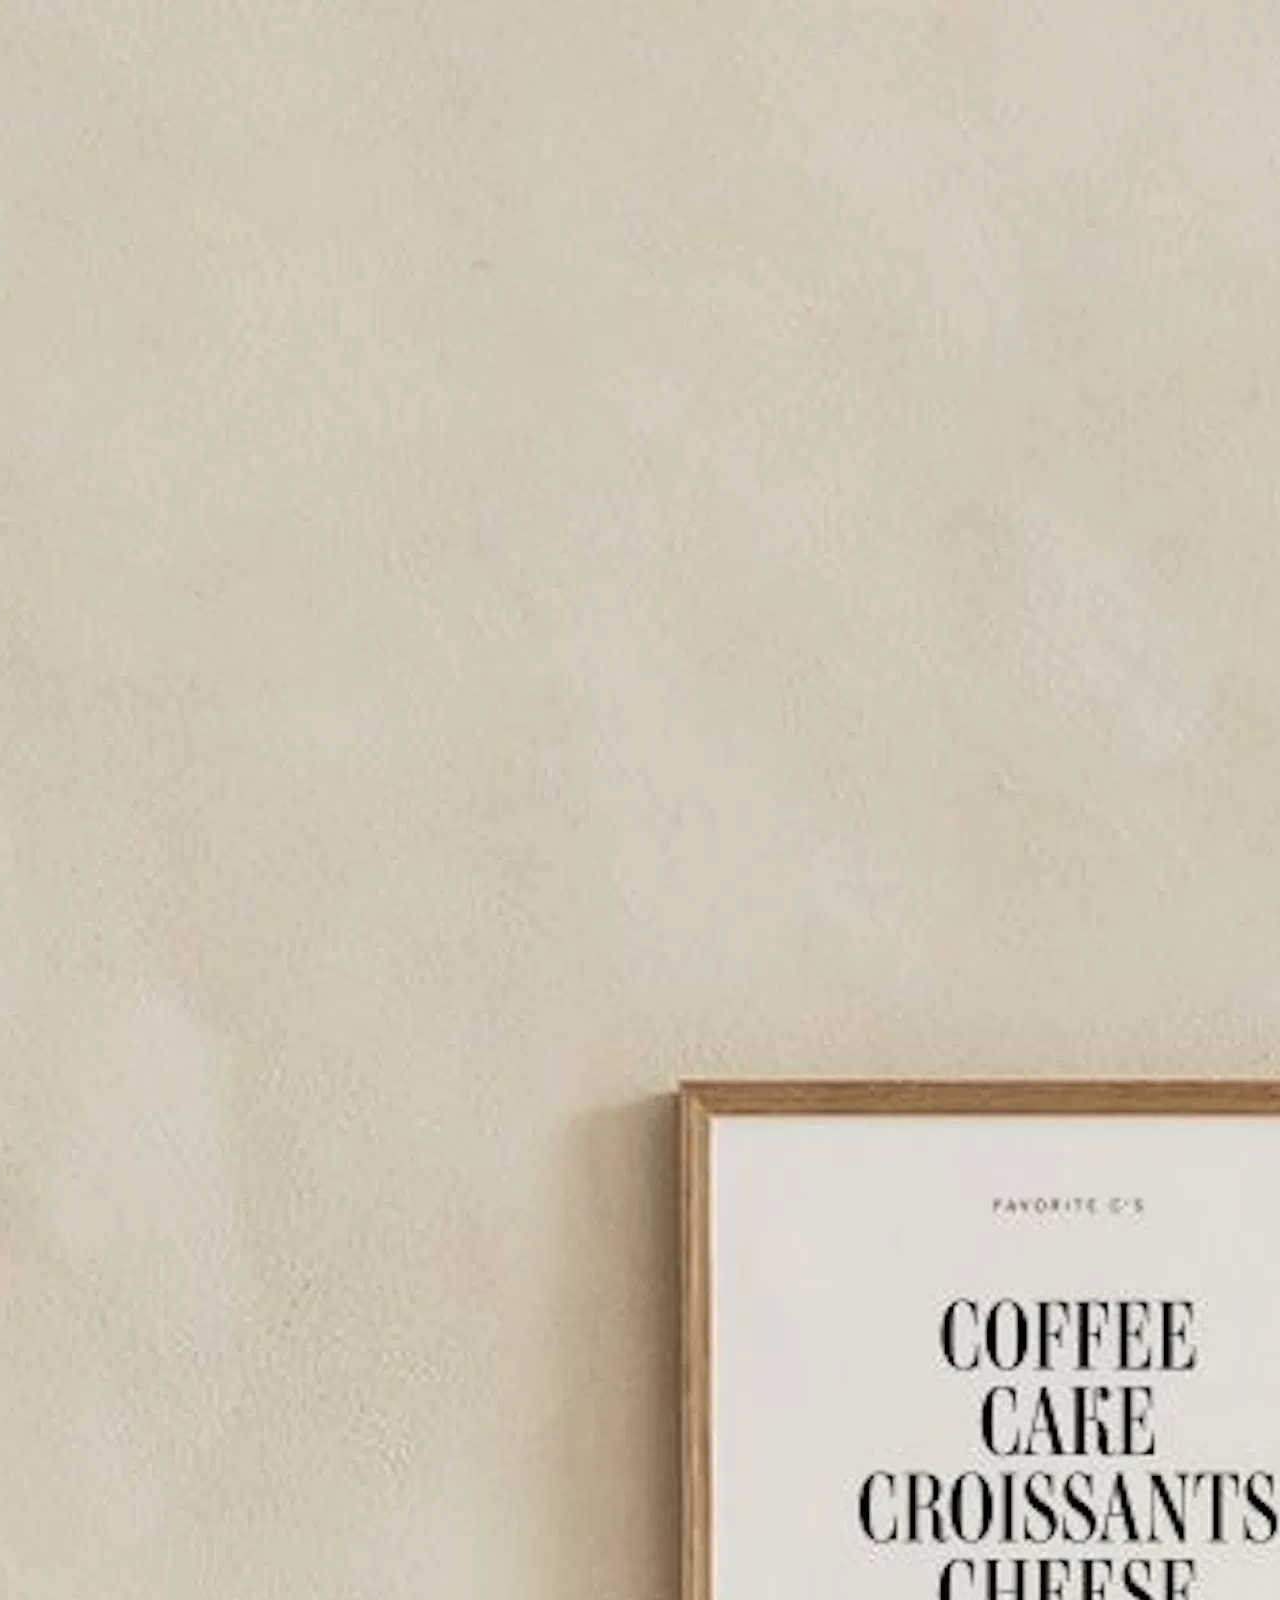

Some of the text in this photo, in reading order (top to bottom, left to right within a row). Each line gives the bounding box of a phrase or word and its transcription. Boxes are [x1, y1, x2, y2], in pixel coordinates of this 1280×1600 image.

[941, 1299, 1196, 1371] COFFEE
[981, 1385, 1155, 1457] CAKE
[858, 1471, 1278, 1543] CROISSANTS
